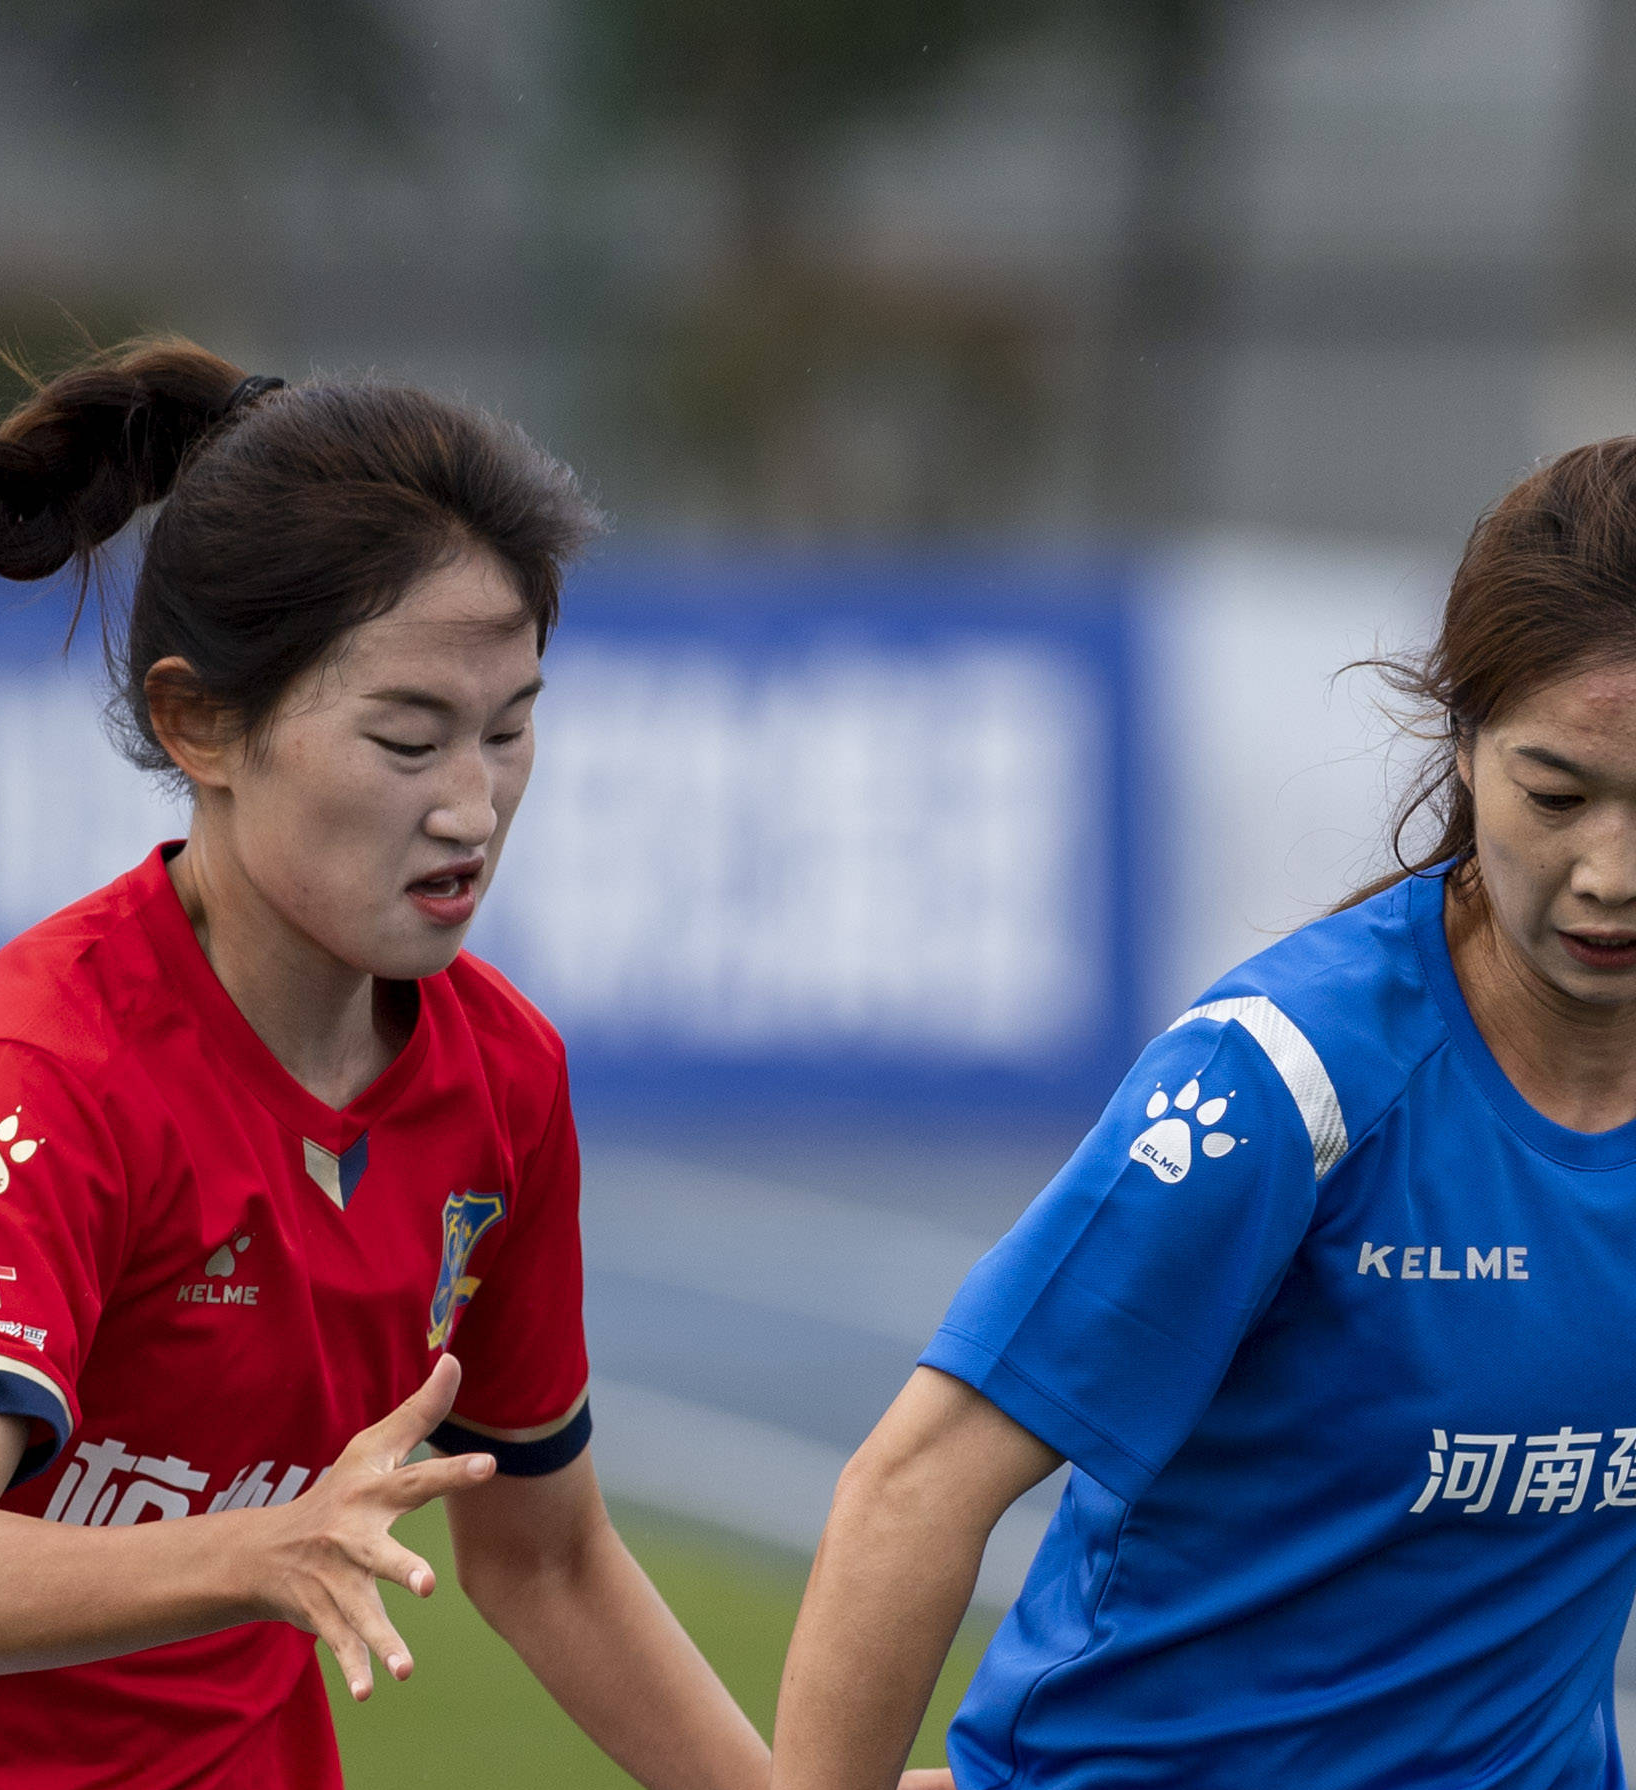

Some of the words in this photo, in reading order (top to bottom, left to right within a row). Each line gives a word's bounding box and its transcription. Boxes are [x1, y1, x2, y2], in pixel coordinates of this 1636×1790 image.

[1133, 1141, 1183, 1178] KELME
[1357, 1241, 1529, 1280] KELME
[176, 1284, 259, 1305] KELME
